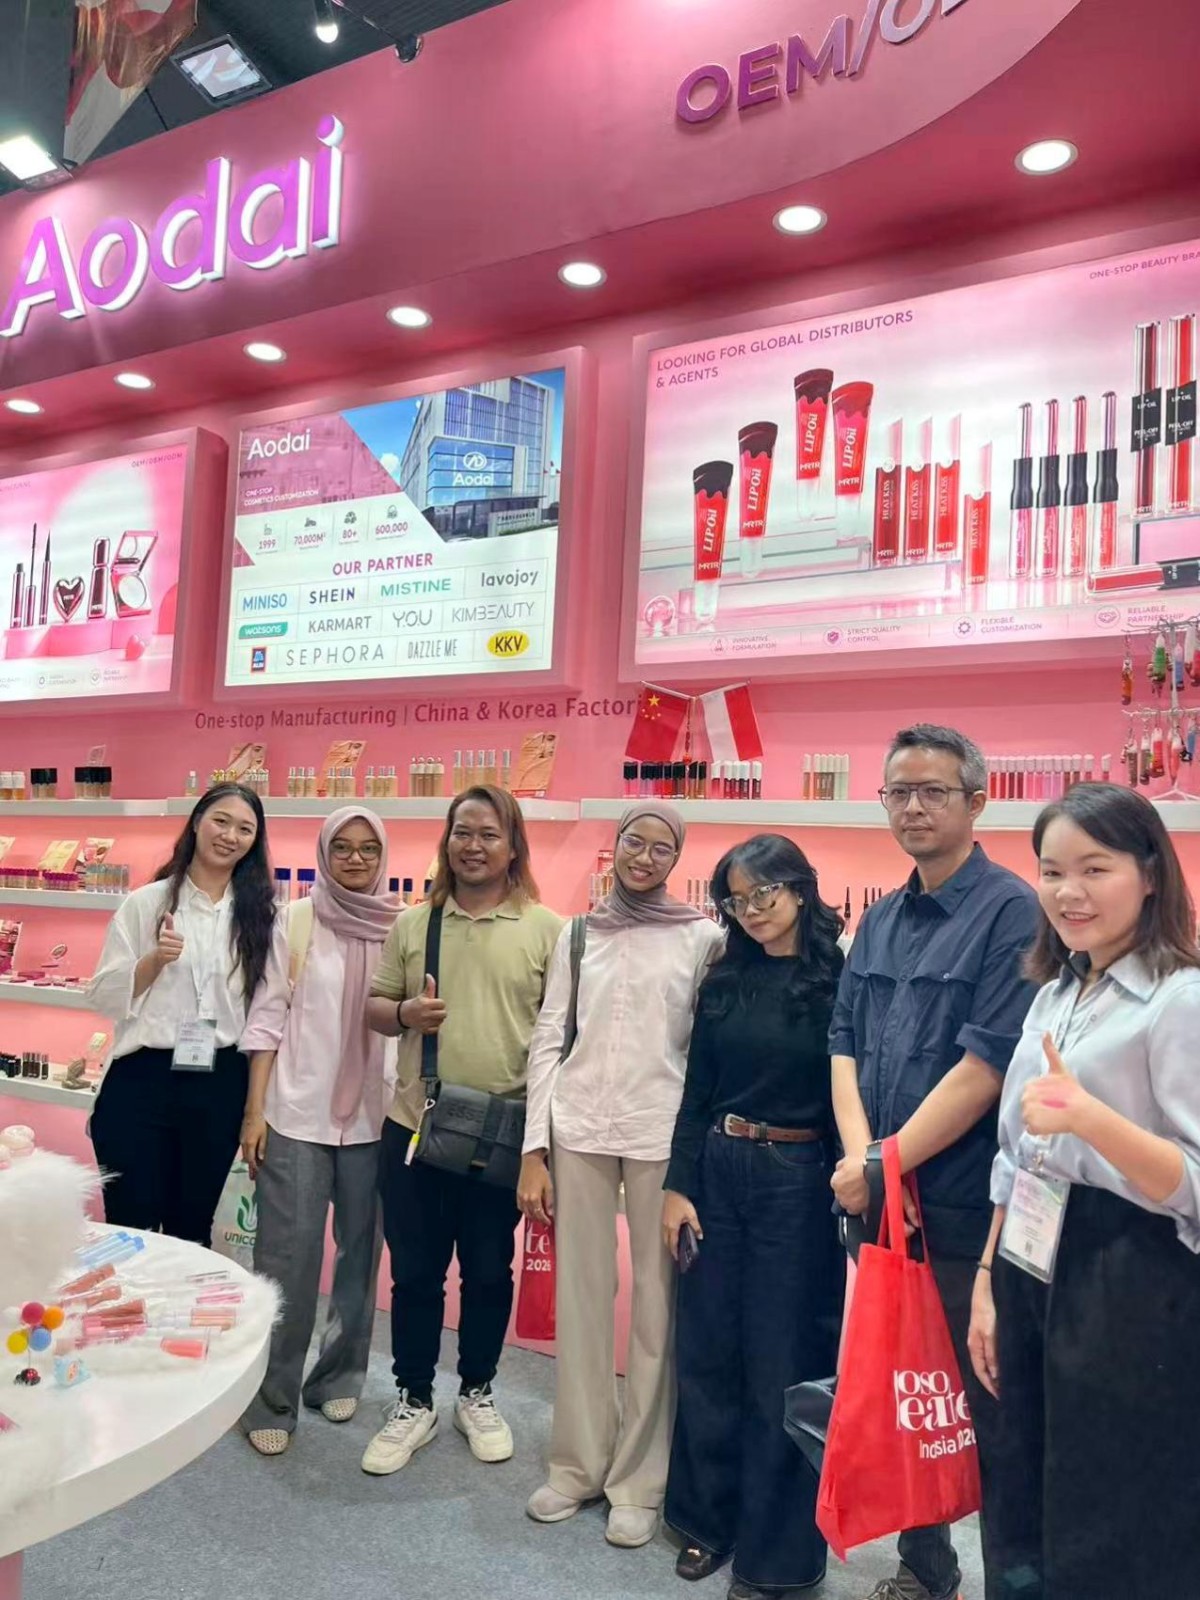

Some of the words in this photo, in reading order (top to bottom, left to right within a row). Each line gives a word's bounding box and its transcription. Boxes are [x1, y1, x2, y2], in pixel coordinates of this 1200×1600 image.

[676, 0, 968, 123] OEM/O
[0, 114, 344, 337] Aodai
[1089, 263, 1139, 280] ONE-STOP
[1141, 254, 1180, 269] BEAUTY
[657, 350, 716, 371] LOOKING
[719, 344, 747, 359] FOR
[750, 333, 804, 353] GLOBAL
[809, 310, 913, 342] DISTRIBUTORS
[656, 376, 665, 388] &
[668, 367, 719, 386] AGENTS
[247, 429, 311, 460] Aodai
[332, 561, 362, 576] OUR
[367, 553, 433, 572] PARTNER
[380, 578, 451, 597] MISTINE
[481, 569, 539, 587] lavojoy
[243, 593, 288, 611] MINISO
[309, 587, 356, 604] SHEIN
[452, 602, 535, 623] KIMBEAUTY
[245, 625, 282, 636] watsons
[308, 616, 372, 633] KARMART
[408, 640, 441, 660] DAZZLE
[444, 639, 458, 657] ME
[495, 635, 523, 653] KKV
[286, 644, 384, 666] SEPHORA
[195, 712, 264, 730] One-stop
[271, 706, 396, 727] Manufacturing
[415, 702, 469, 722] China
[476, 701, 490, 720] &
[498, 701, 557, 720] Korea
